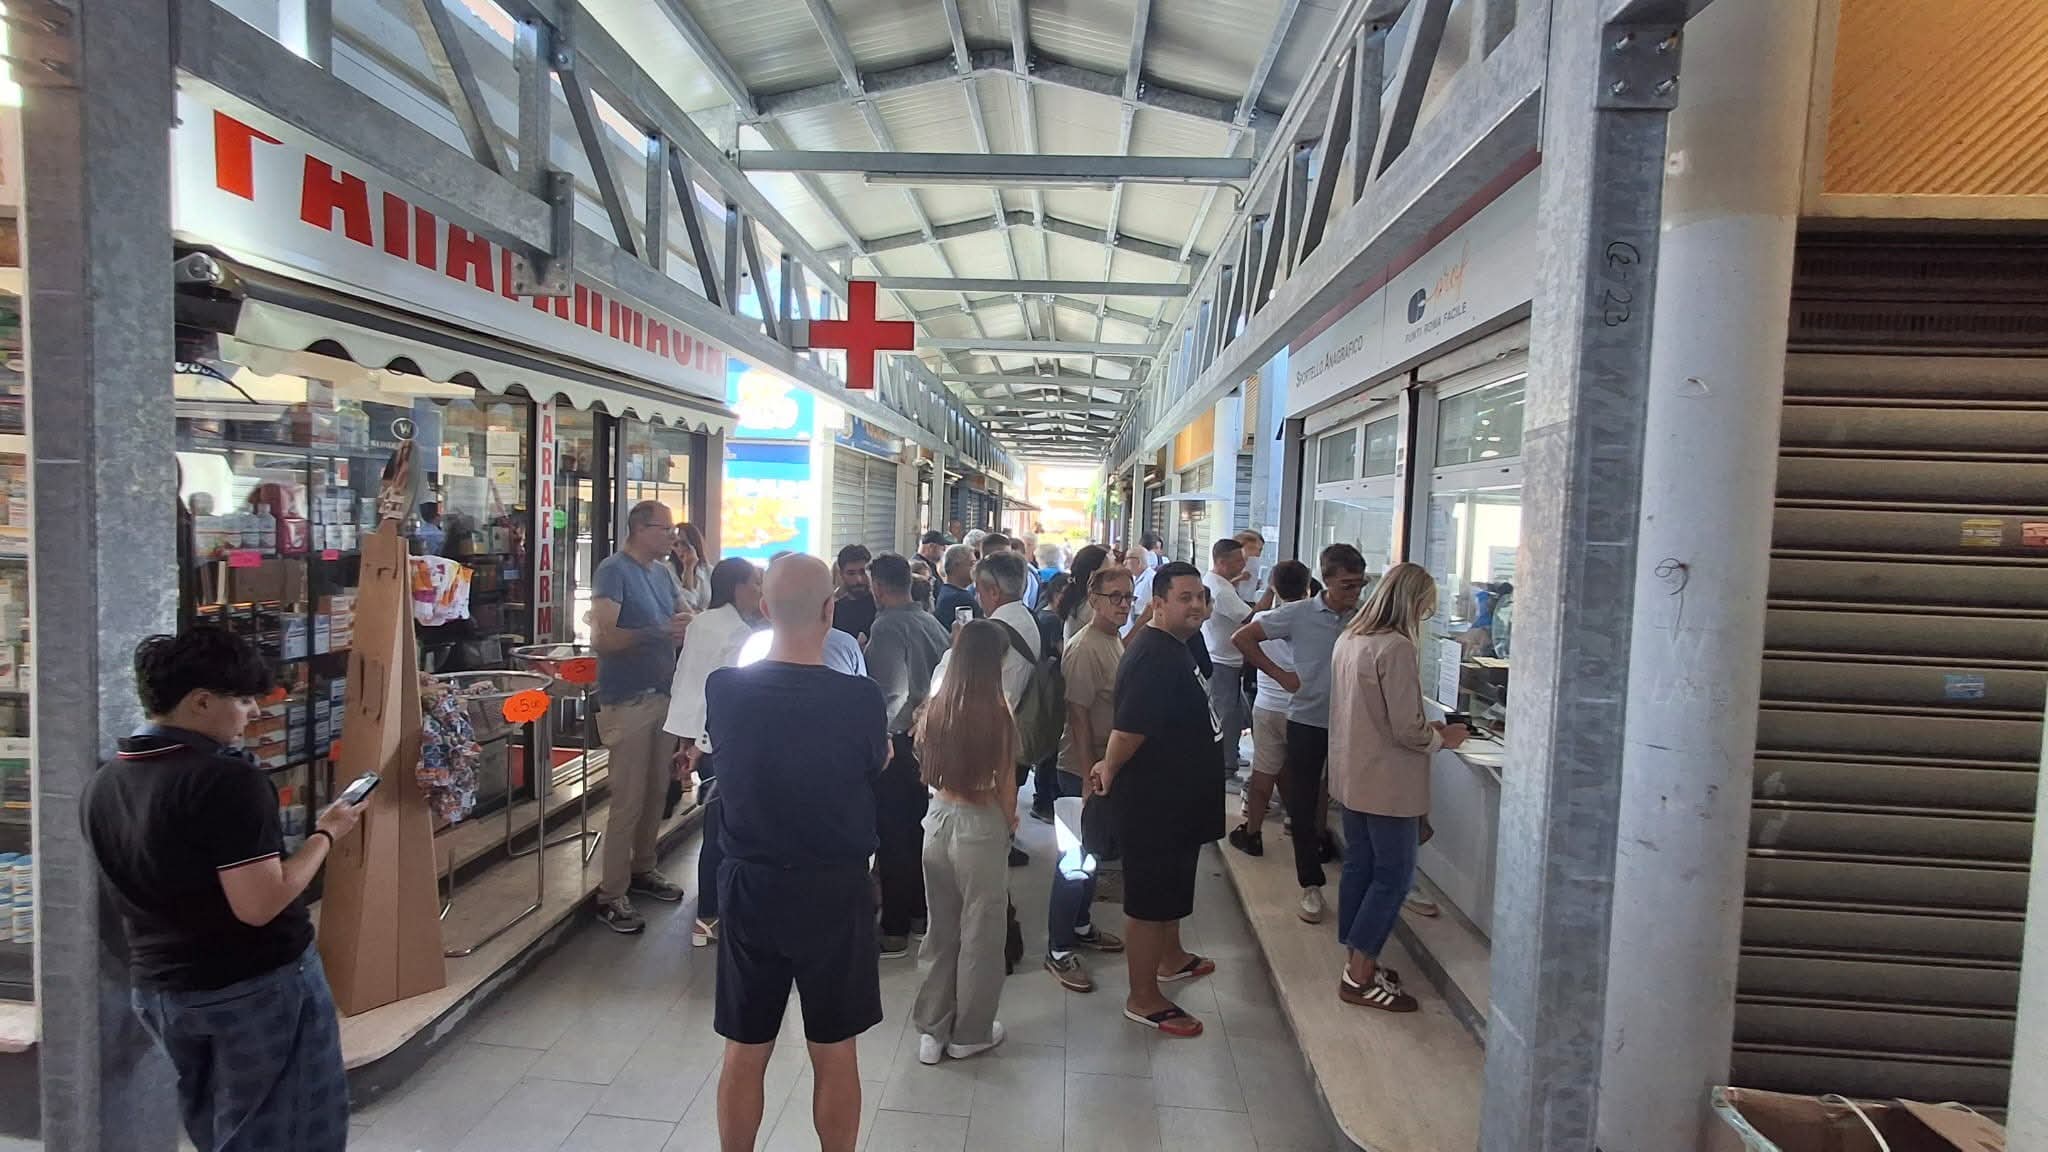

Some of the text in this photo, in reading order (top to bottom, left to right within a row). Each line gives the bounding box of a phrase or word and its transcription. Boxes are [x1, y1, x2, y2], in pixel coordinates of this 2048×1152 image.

[1424, 316, 1441, 333] ROMA
[1443, 302, 1467, 321] FACILE
[1296, 335, 1364, 388] SPORTELLO ANAGRAFICO
